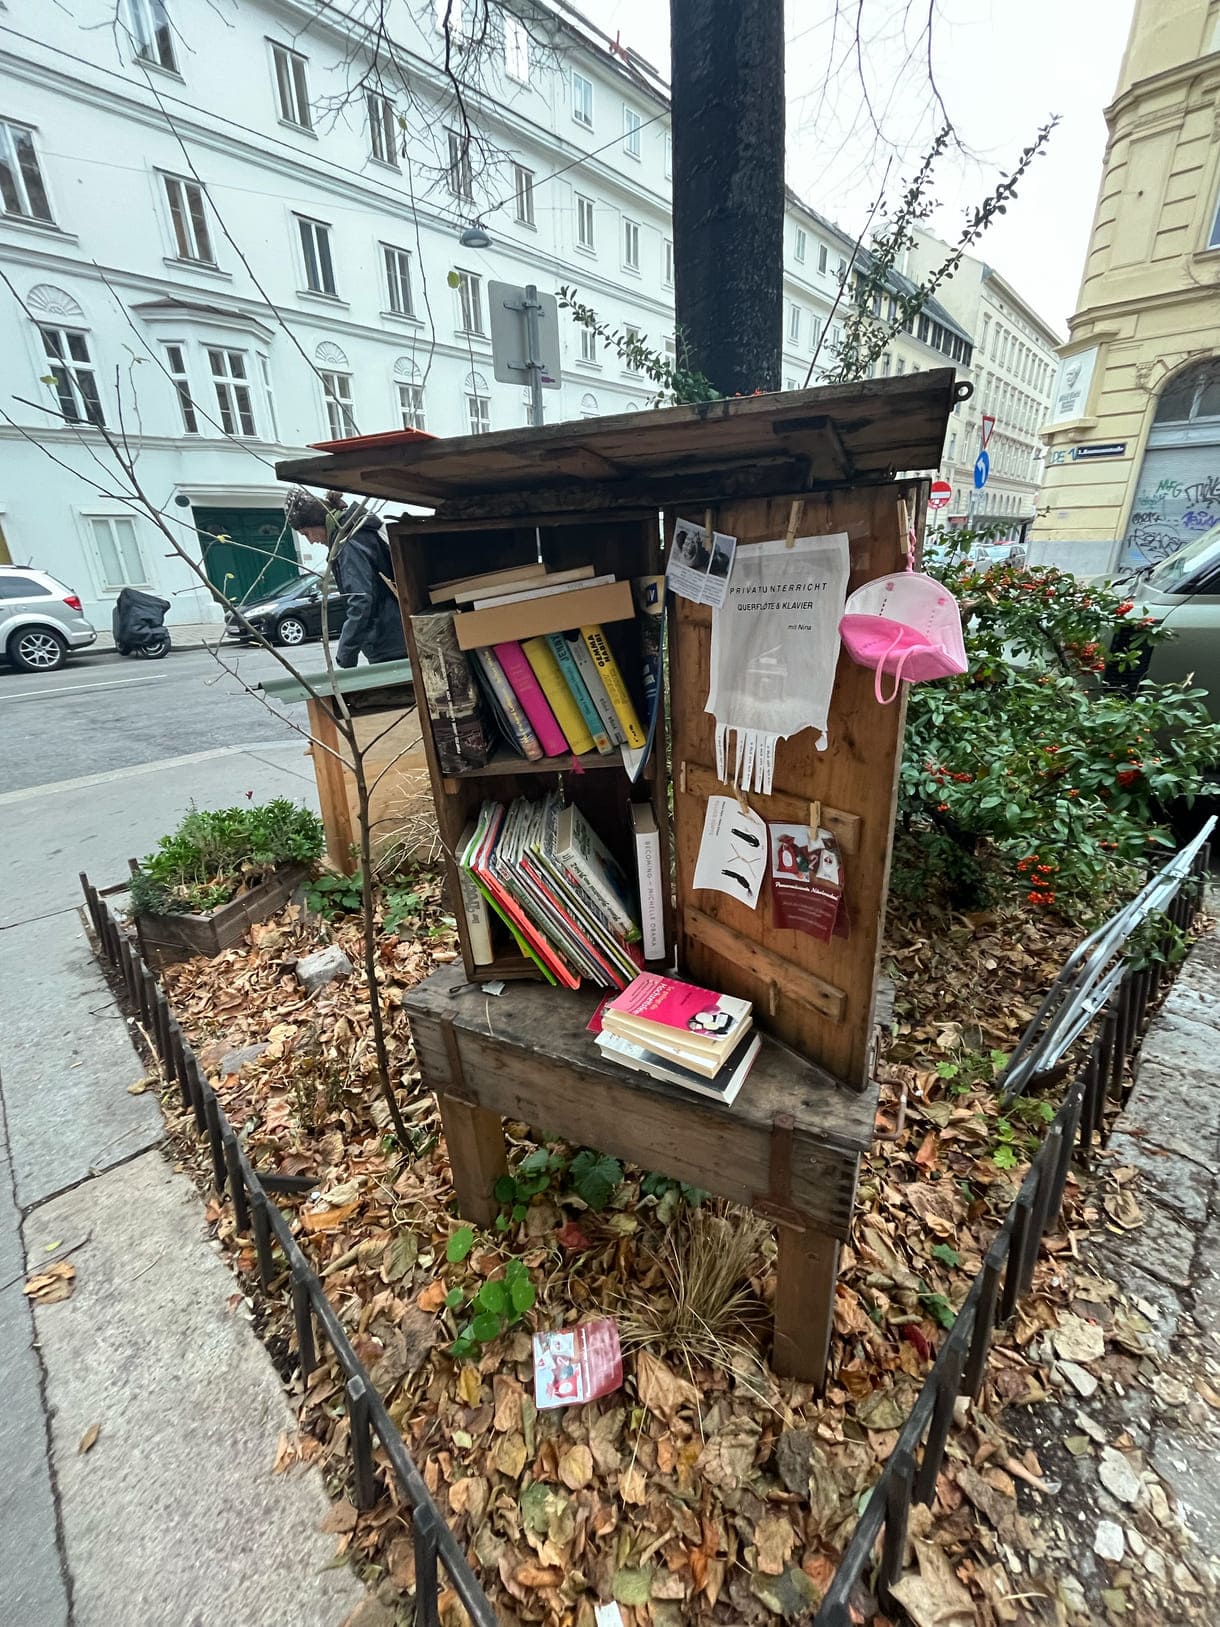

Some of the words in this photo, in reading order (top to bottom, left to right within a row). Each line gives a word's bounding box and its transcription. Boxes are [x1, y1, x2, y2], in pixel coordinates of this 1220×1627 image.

[729, 582, 828, 594] PRIVATUNTERRICHT
[782, 601, 813, 610] KLAVIER
[550, 634, 569, 661] JENNY
[587, 634, 605, 667] GEMMA
[594, 633, 610, 663] HABIBI
[643, 840, 651, 878] BECOMING
[646, 887, 654, 920] MICHELLE
